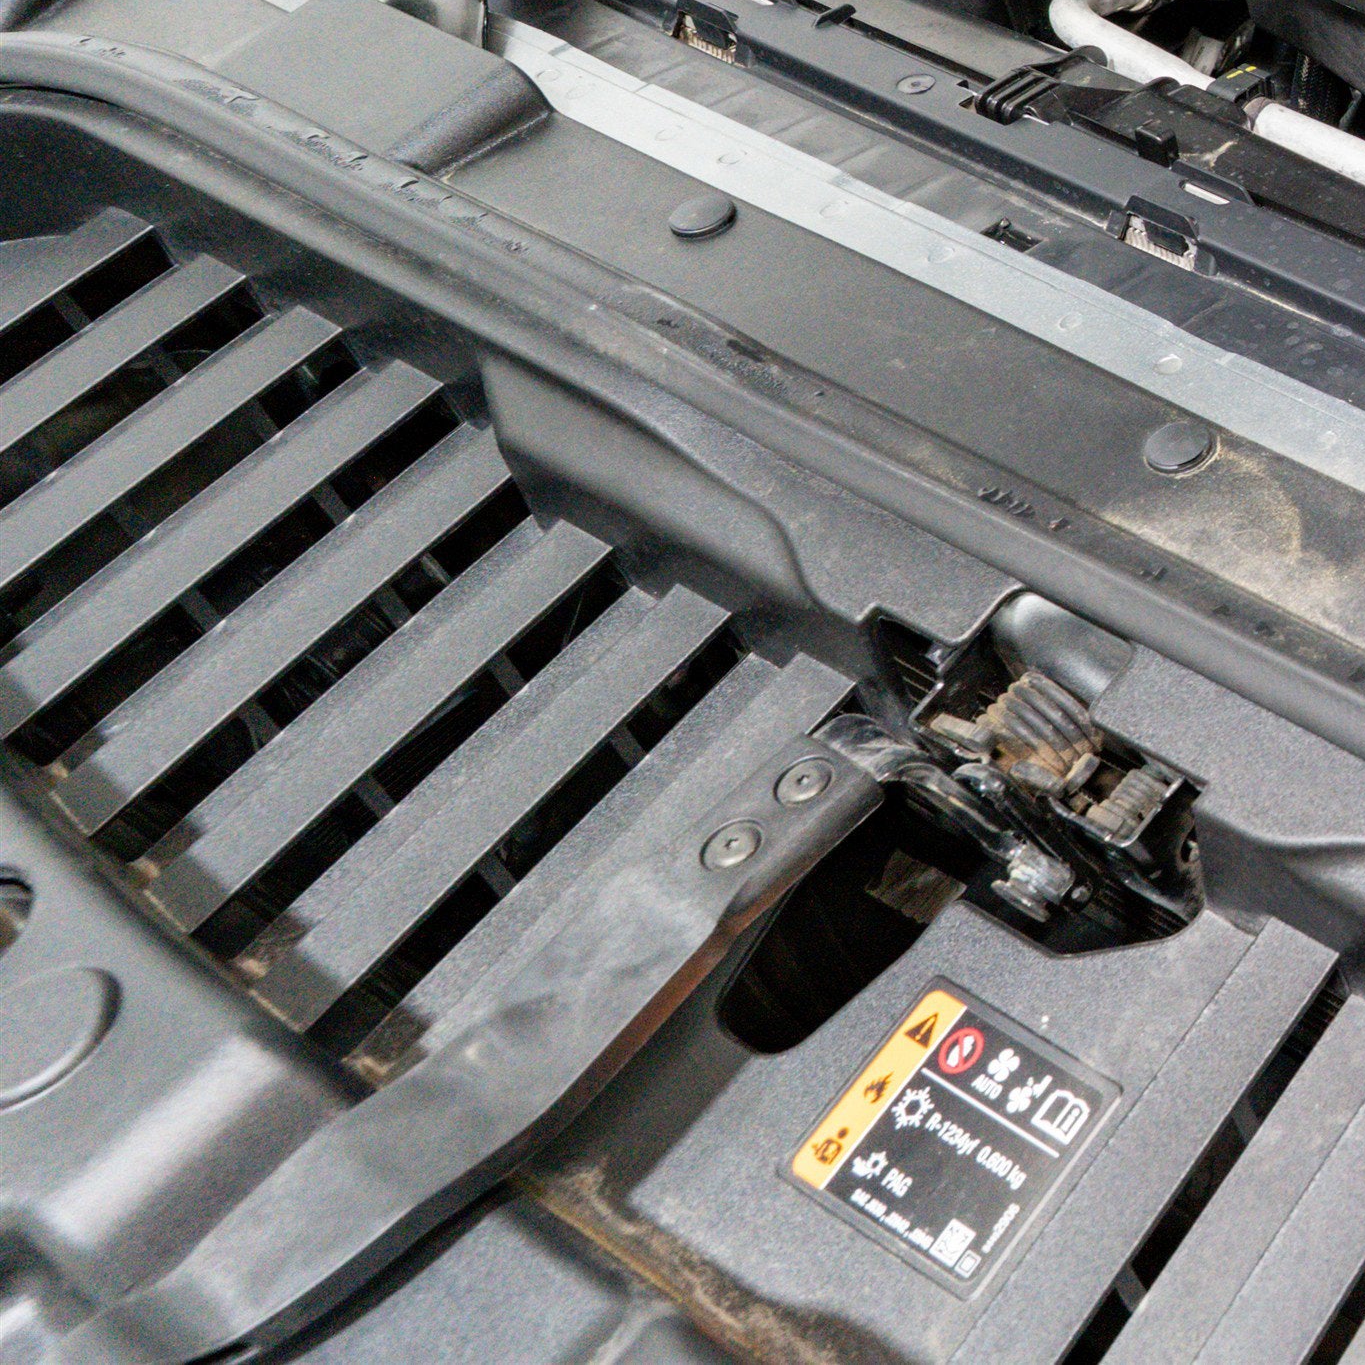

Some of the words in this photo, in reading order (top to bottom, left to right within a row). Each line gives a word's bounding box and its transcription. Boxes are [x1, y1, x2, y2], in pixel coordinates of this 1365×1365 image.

[970, 1073, 1003, 1101] AUTO
[925, 1111, 981, 1156] R-1234yf
[975, 1145, 1014, 1178] 0.600
[1005, 1164, 1028, 1191] kg
[881, 1167, 914, 1199] PAG
